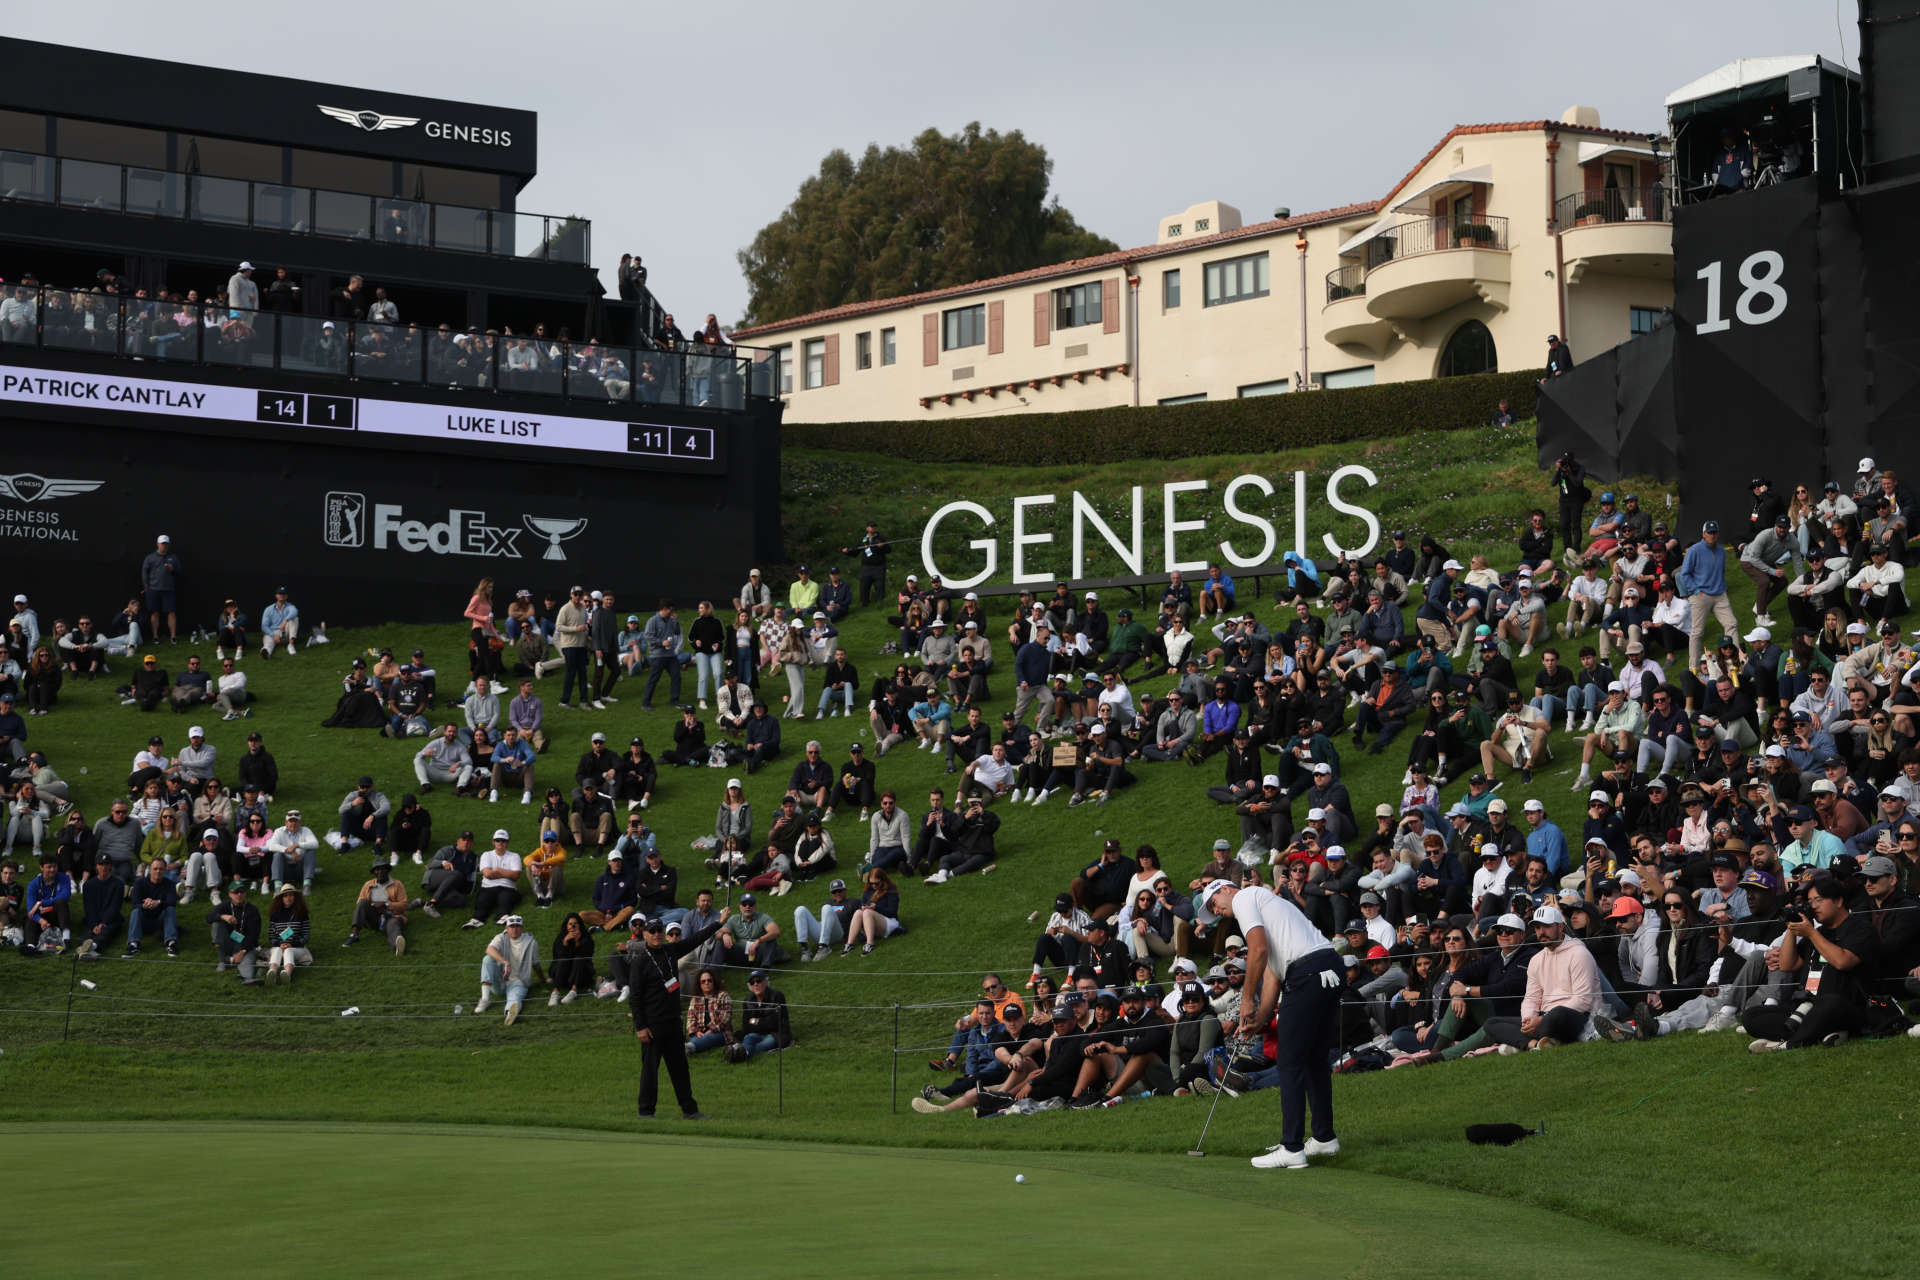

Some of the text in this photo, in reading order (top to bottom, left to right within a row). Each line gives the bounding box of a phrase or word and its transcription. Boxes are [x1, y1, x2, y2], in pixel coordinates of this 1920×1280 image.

[425, 121, 512, 147] GENESIS
[1696, 250, 1788, 335] 18
[4, 375, 206, 409] PATRICK CANTLAY
[328, 404, 336, 420] 1
[447, 415, 541, 438] LUKE LIST
[685, 435, 696, 451] 4
[374, 504, 522, 558] FedEx
[921, 464, 1381, 590] GENESIS
